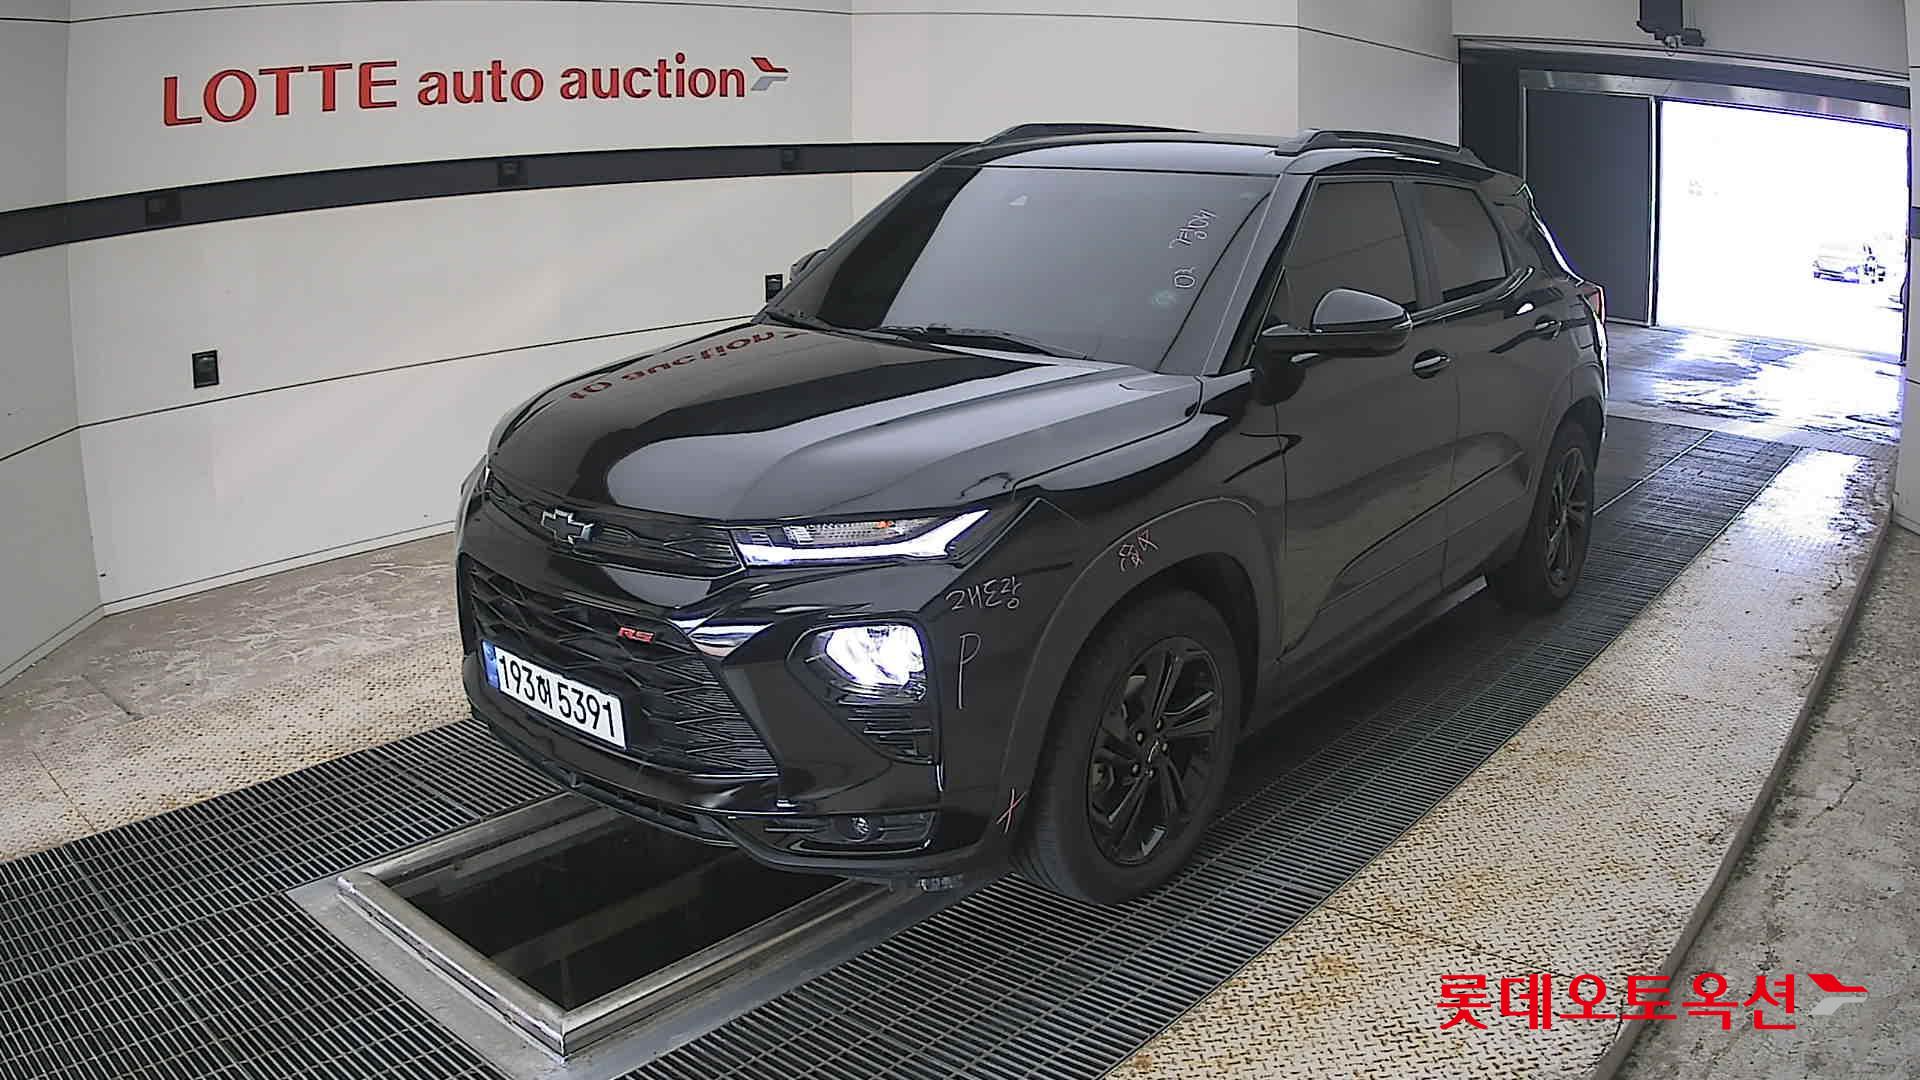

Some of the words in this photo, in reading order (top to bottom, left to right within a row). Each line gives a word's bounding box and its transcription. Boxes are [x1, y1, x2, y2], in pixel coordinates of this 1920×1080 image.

[163, 60, 397, 126] LOTTE
[417, 60, 544, 106] auto
[560, 52, 747, 101] auction
[618, 626, 655, 643] RS
[958, 632, 982, 710] P
[499, 654, 553, 710] 193허
[557, 681, 616, 739] 5391
